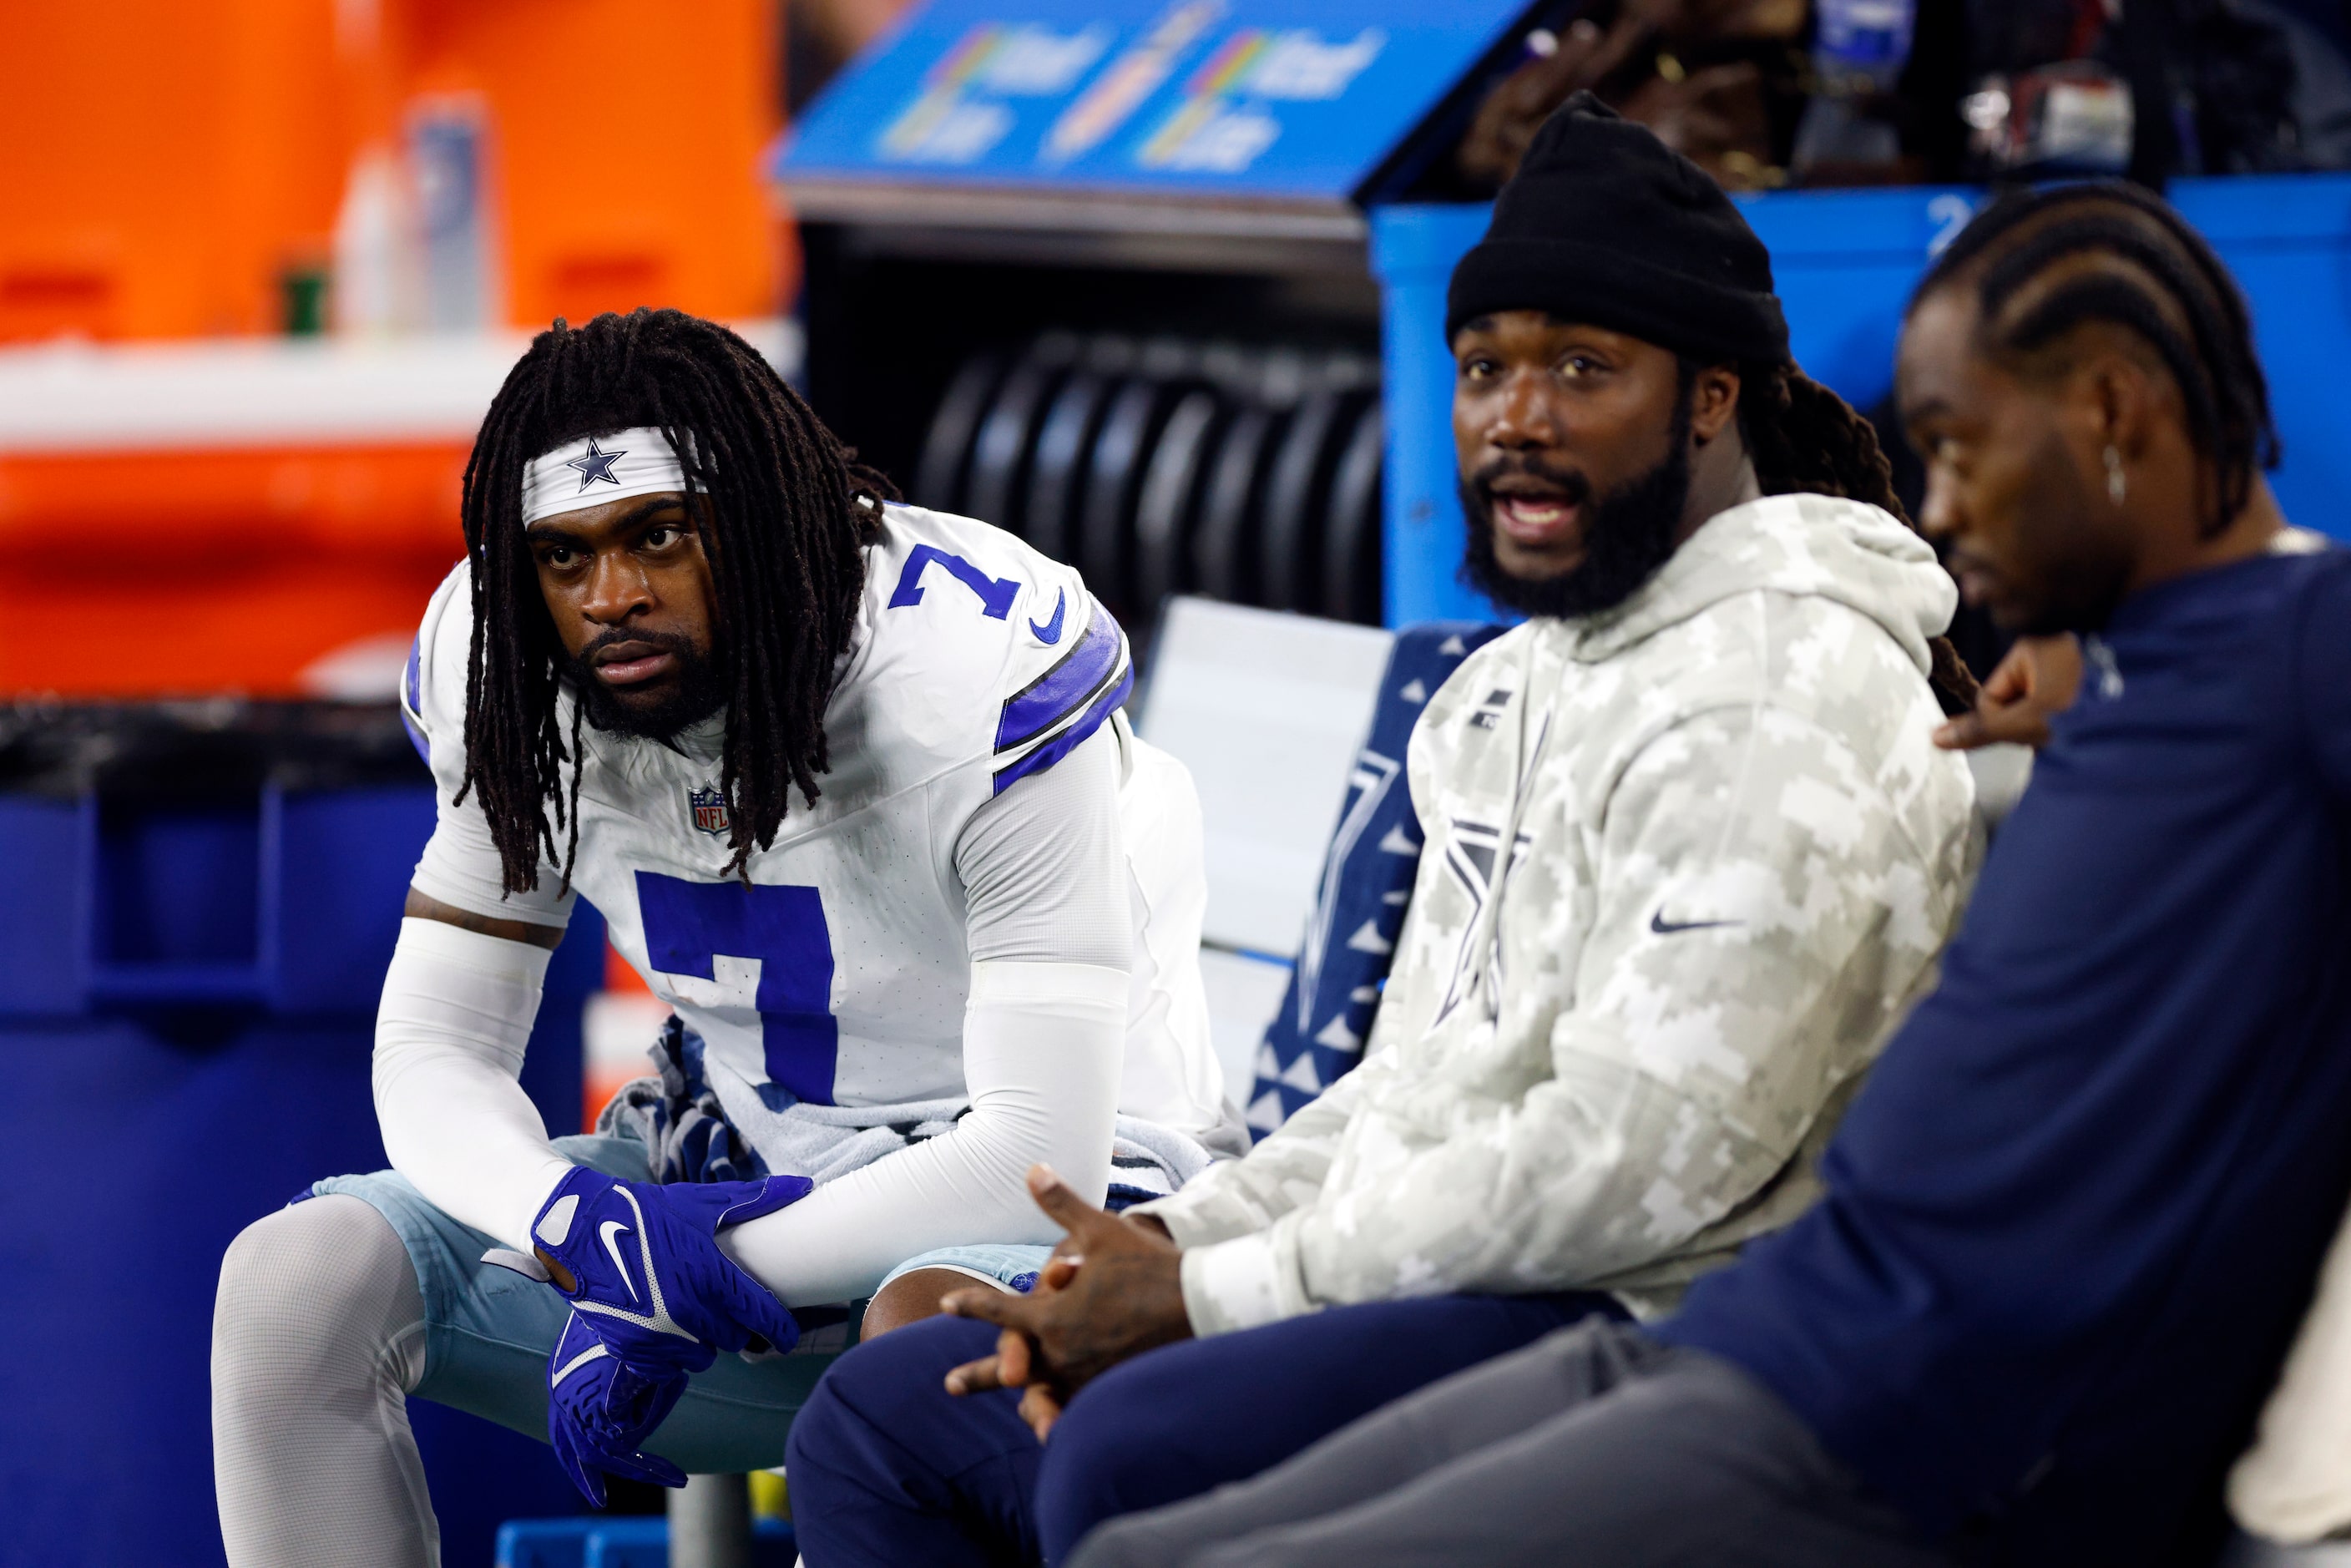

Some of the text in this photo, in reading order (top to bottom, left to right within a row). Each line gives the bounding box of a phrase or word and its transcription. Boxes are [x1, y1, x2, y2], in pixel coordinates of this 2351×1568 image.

[887, 544, 1021, 620] 7
[696, 807, 727, 830] NFL
[635, 869, 838, 1106] 7
